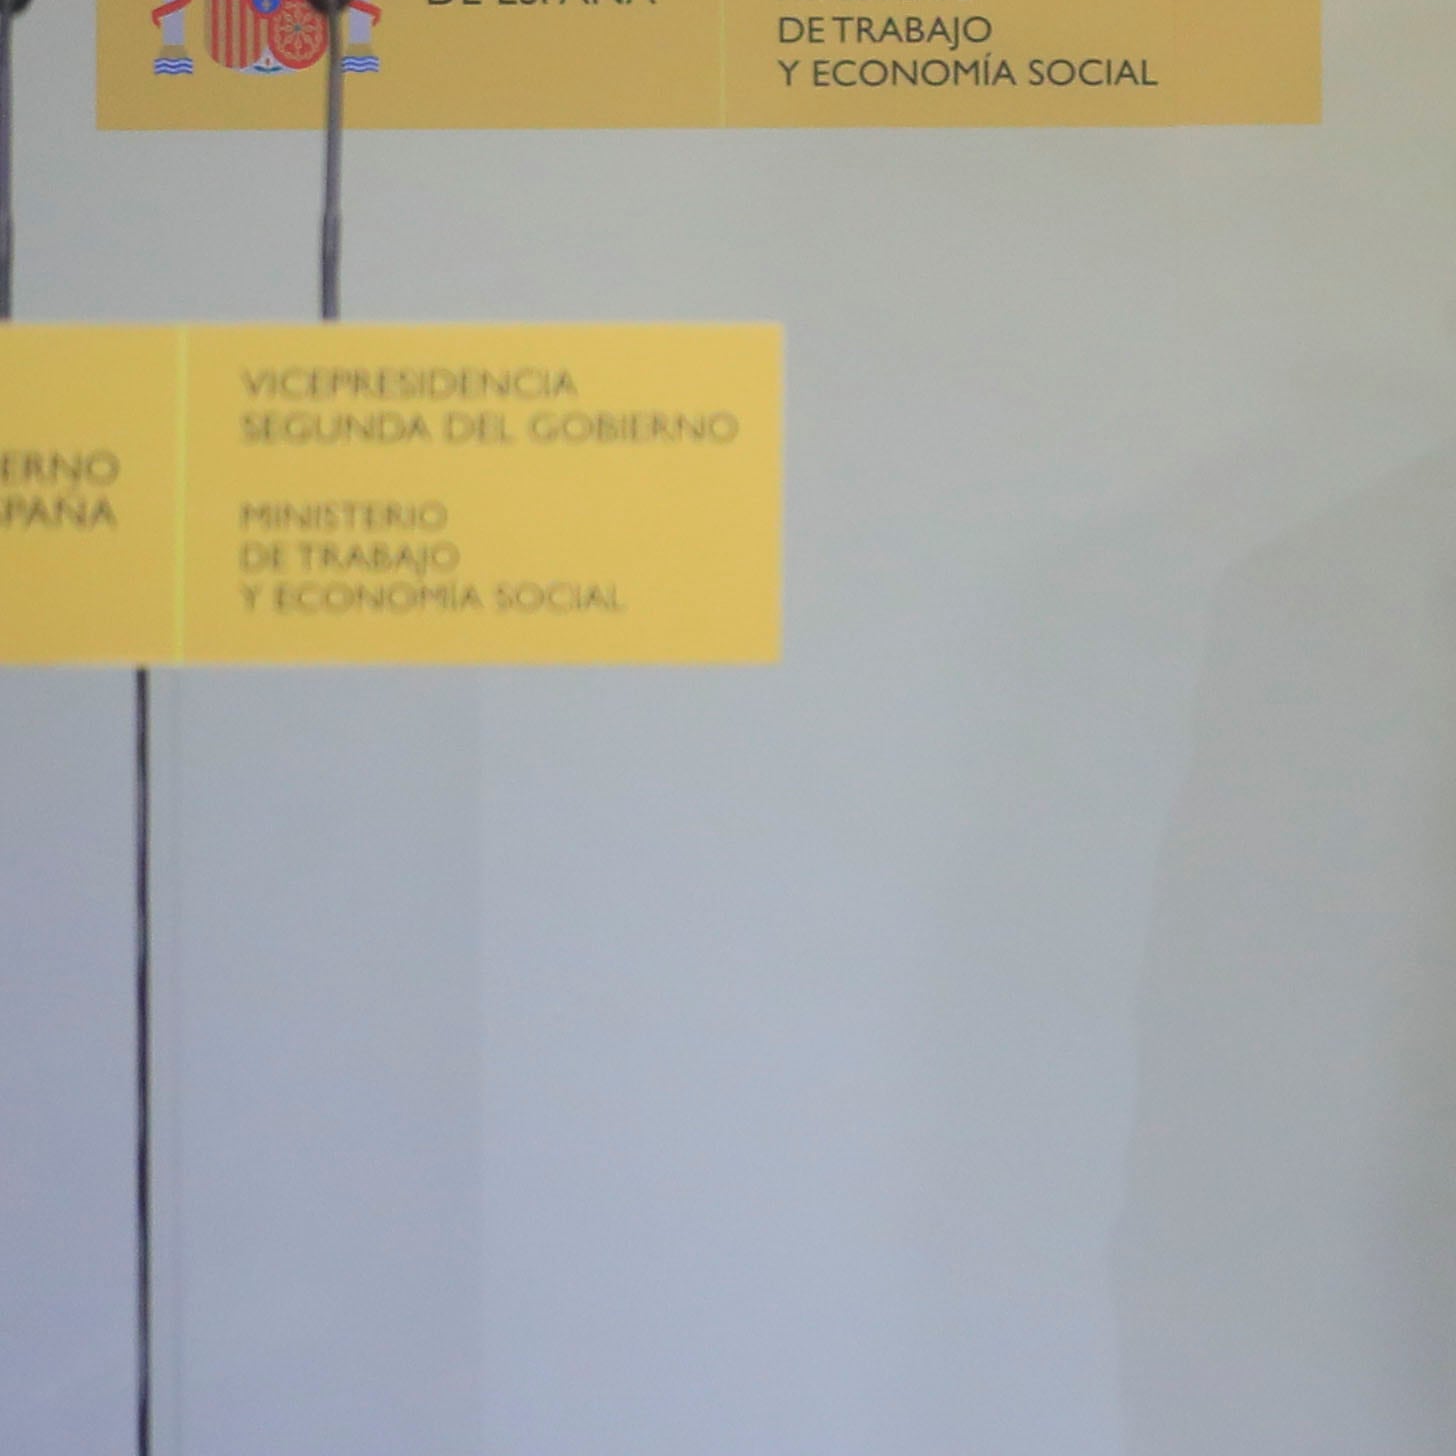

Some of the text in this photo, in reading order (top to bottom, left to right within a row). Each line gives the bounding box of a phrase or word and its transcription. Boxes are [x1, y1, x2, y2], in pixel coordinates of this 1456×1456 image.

[780, 16, 991, 51] DE TRABAJO
[779, 53, 1158, 86] Y ECONOMÍA SOCIAL
[243, 370, 577, 399] VICEPRESIDENCIA
[241, 413, 740, 443] SEGUNDA DEL GOBIERNO
[0, 447, 122, 486] ERNO
[0, 489, 118, 531] PAÑA
[241, 502, 449, 531] MINISTERIO
[241, 543, 461, 576] DE TRABAJO
[241, 581, 626, 614] Y ECONOMÍA SOCIAL
